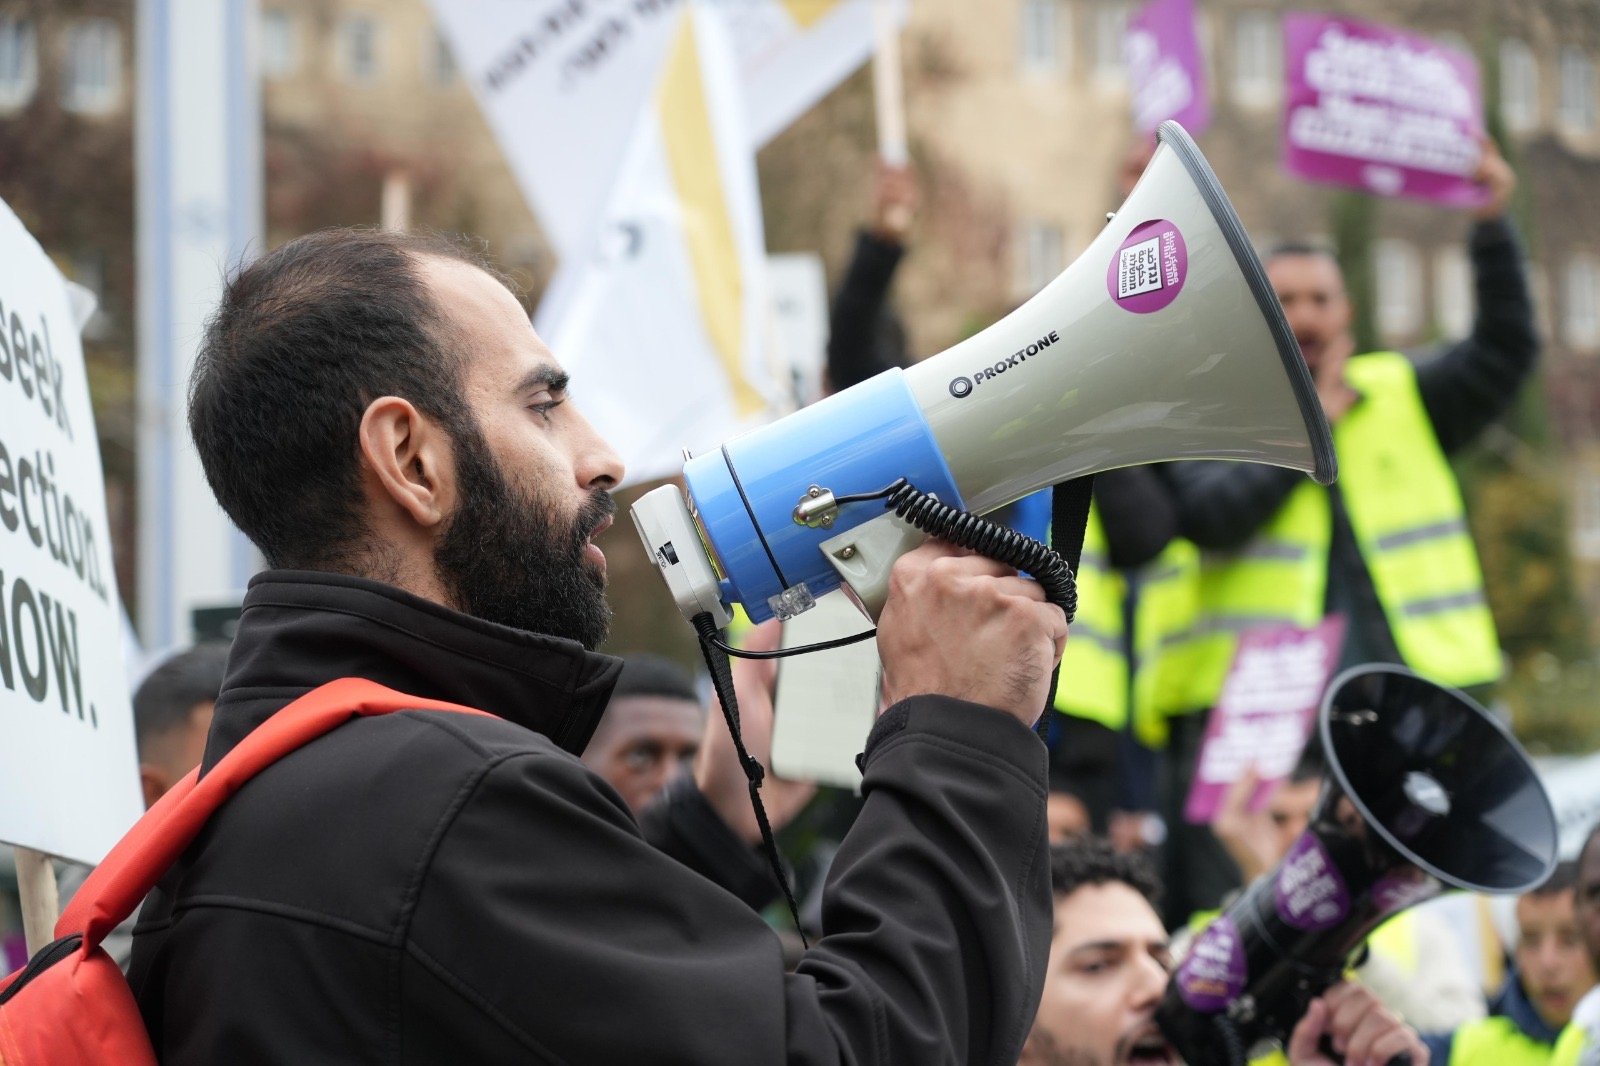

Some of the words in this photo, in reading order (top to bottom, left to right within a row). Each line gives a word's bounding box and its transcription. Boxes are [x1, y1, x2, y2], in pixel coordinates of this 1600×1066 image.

[1148, 247, 1156, 264] ضد
[1163, 231, 1172, 258] החיים
[1129, 253, 1137, 290] ממשלת
[1136, 250, 1146, 286] حكومة
[1148, 262, 1158, 284] נגד
[1165, 261, 1174, 286] מחנה
[973, 330, 1060, 385] PROXTONE
